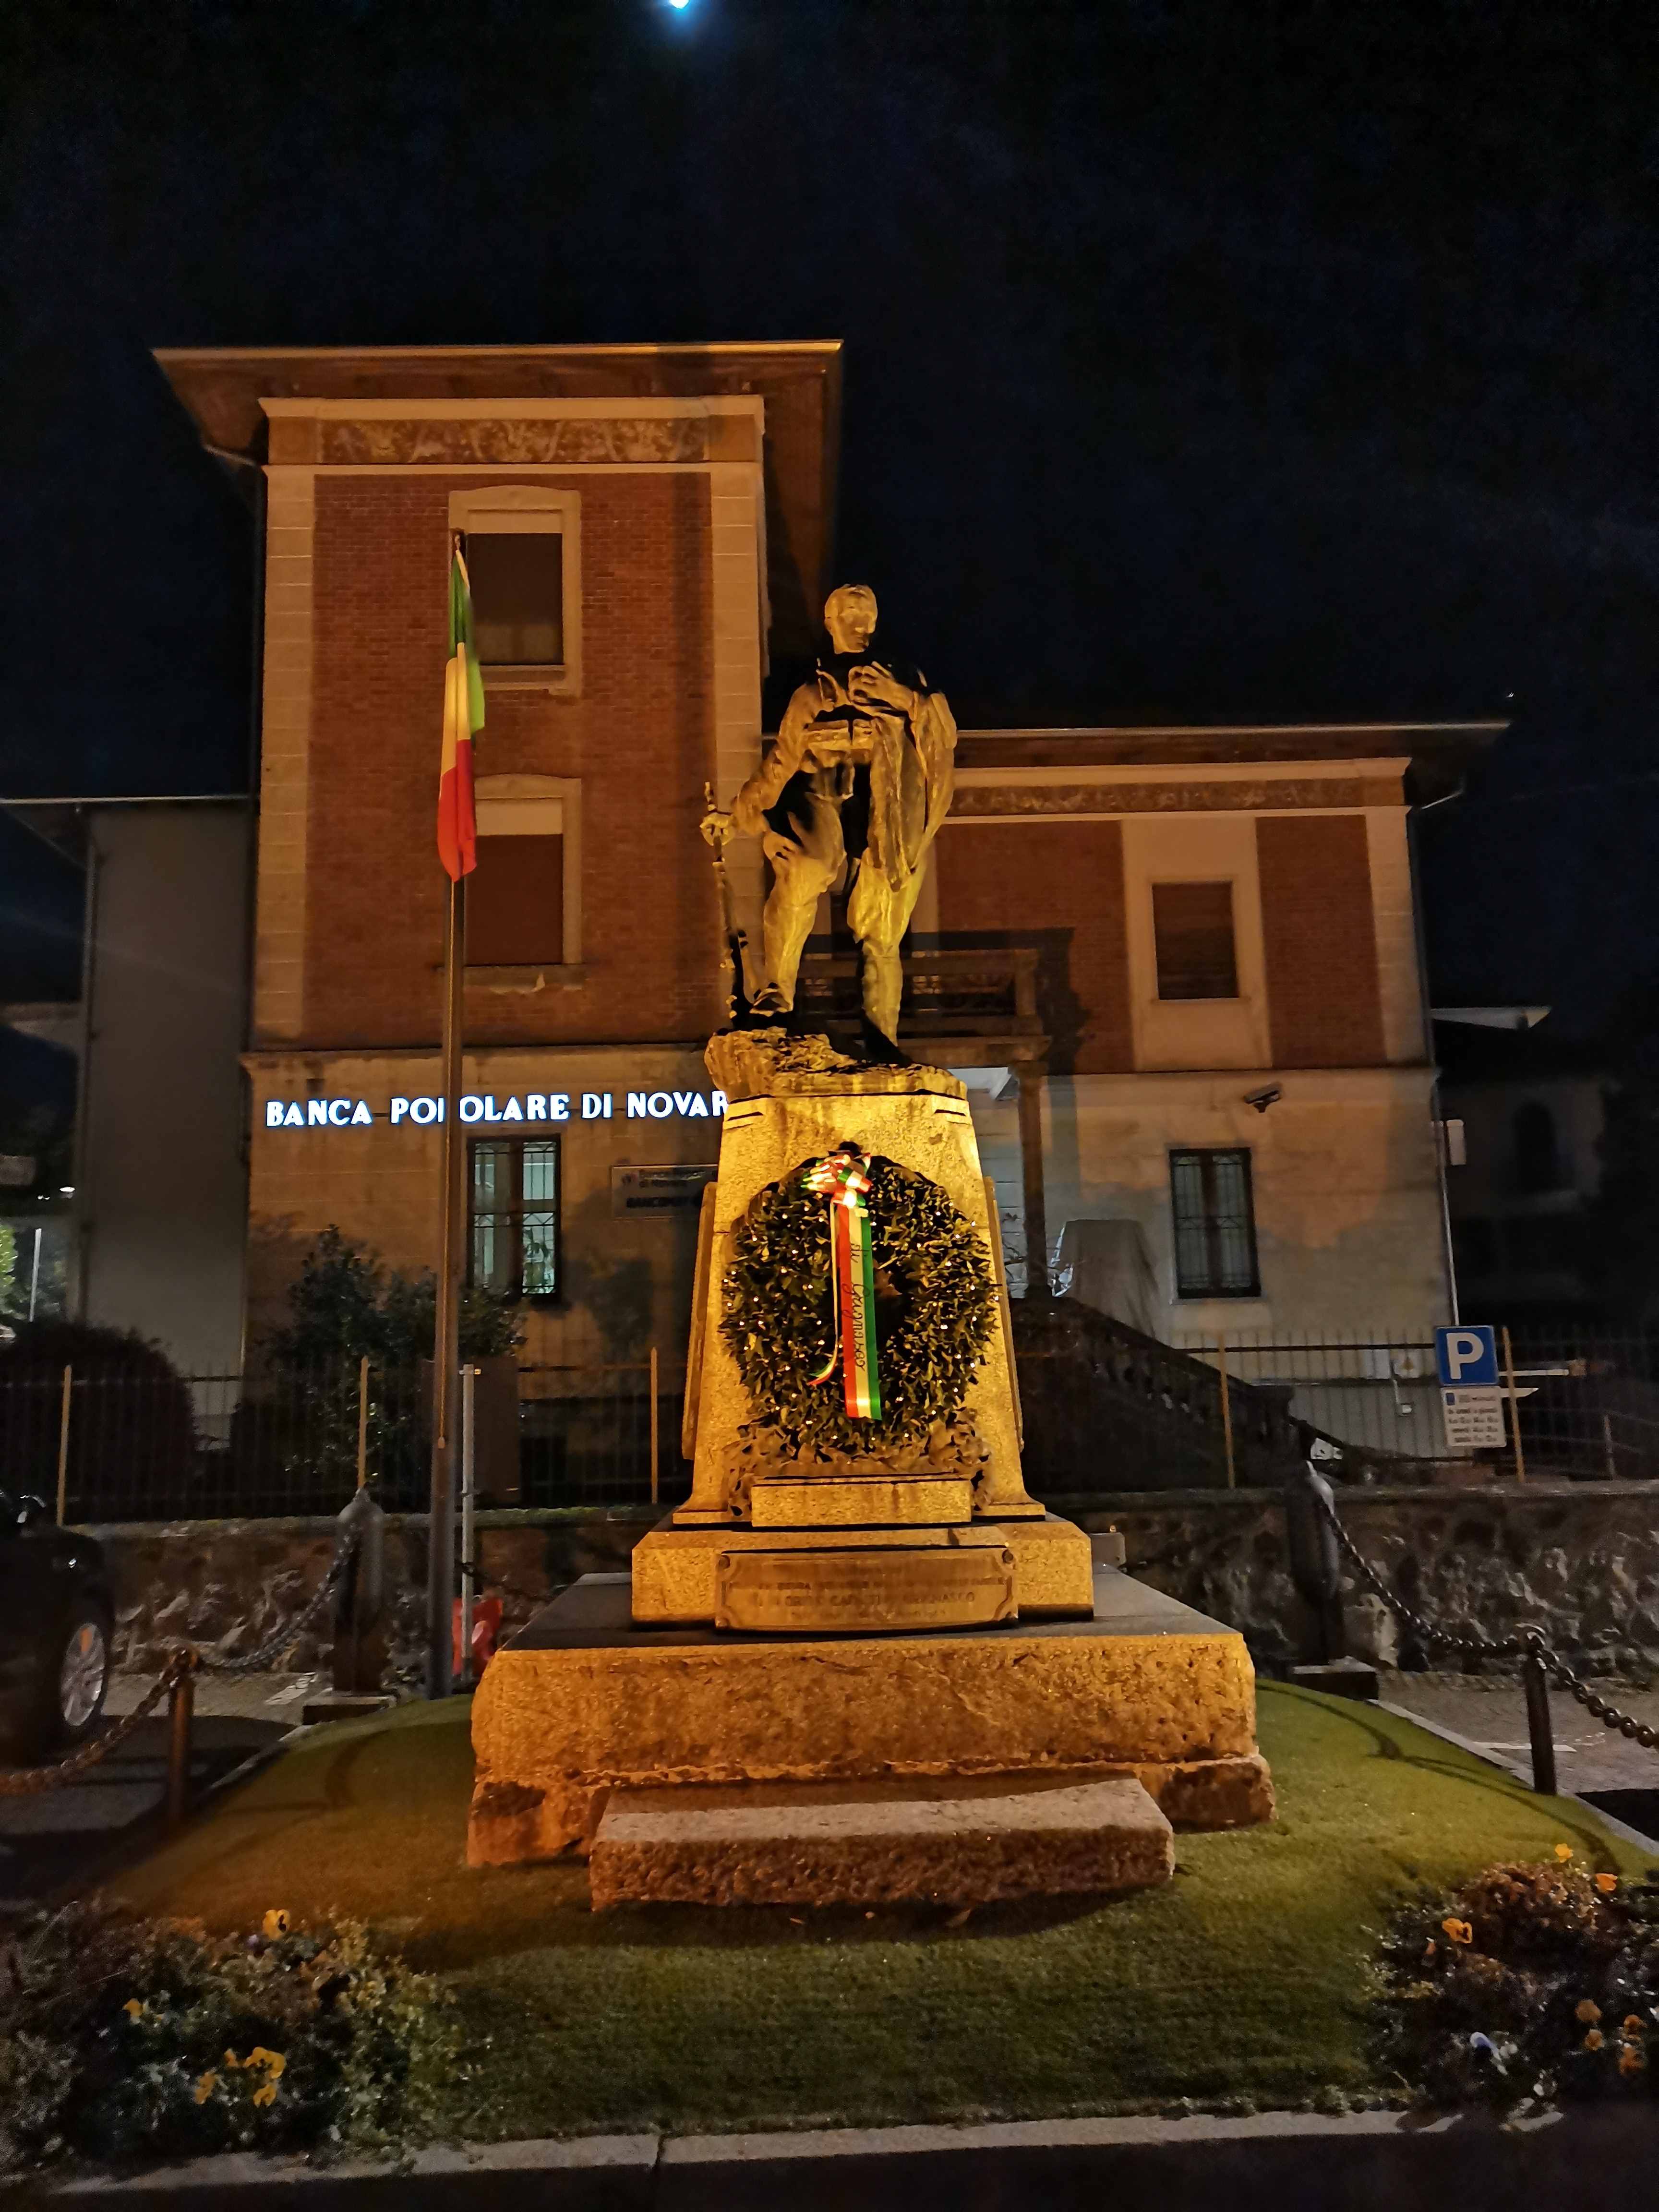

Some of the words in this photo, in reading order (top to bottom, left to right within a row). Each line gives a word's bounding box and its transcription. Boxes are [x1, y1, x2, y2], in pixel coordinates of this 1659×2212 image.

[266, 1099, 373, 1127] BANCA
[581, 1093, 613, 1119] DI
[850, 1243, 870, 1263] di
[1446, 1332, 1485, 1380] P
